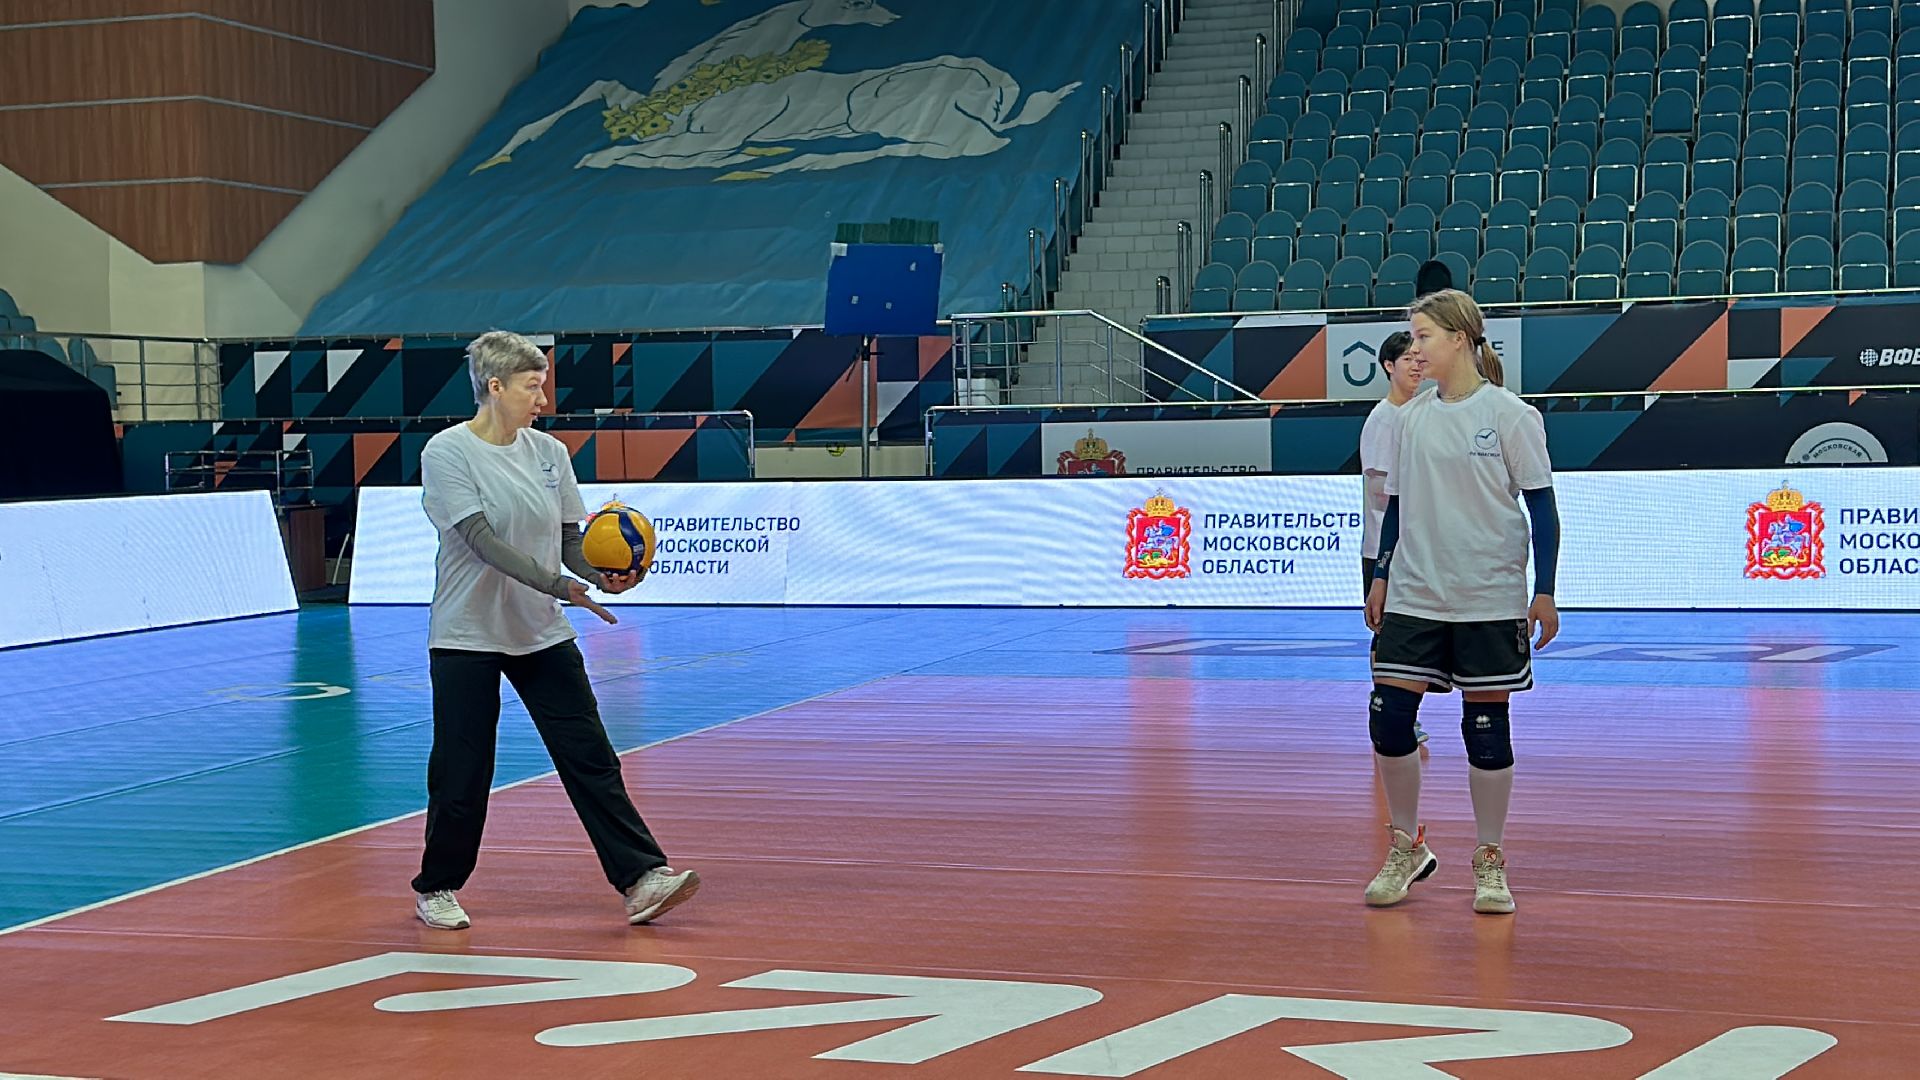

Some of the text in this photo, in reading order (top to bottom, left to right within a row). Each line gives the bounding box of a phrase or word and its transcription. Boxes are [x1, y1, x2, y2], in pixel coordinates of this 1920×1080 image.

[653, 516, 801, 532] ПРАВИТЕЛЬСТВО
[1204, 512, 1361, 529] ПРАВИТЕЛЬСТВ
[1840, 507, 1919, 525] ПРАВИ
[1203, 531, 1341, 551] МОСКОВСКОЙ
[1839, 533, 1920, 550] МОСКО
[649, 560, 730, 575] ОБЛАСТИ
[1202, 558, 1295, 575] ОБЛАСТИ
[1839, 557, 1919, 575] ОБЛАС
